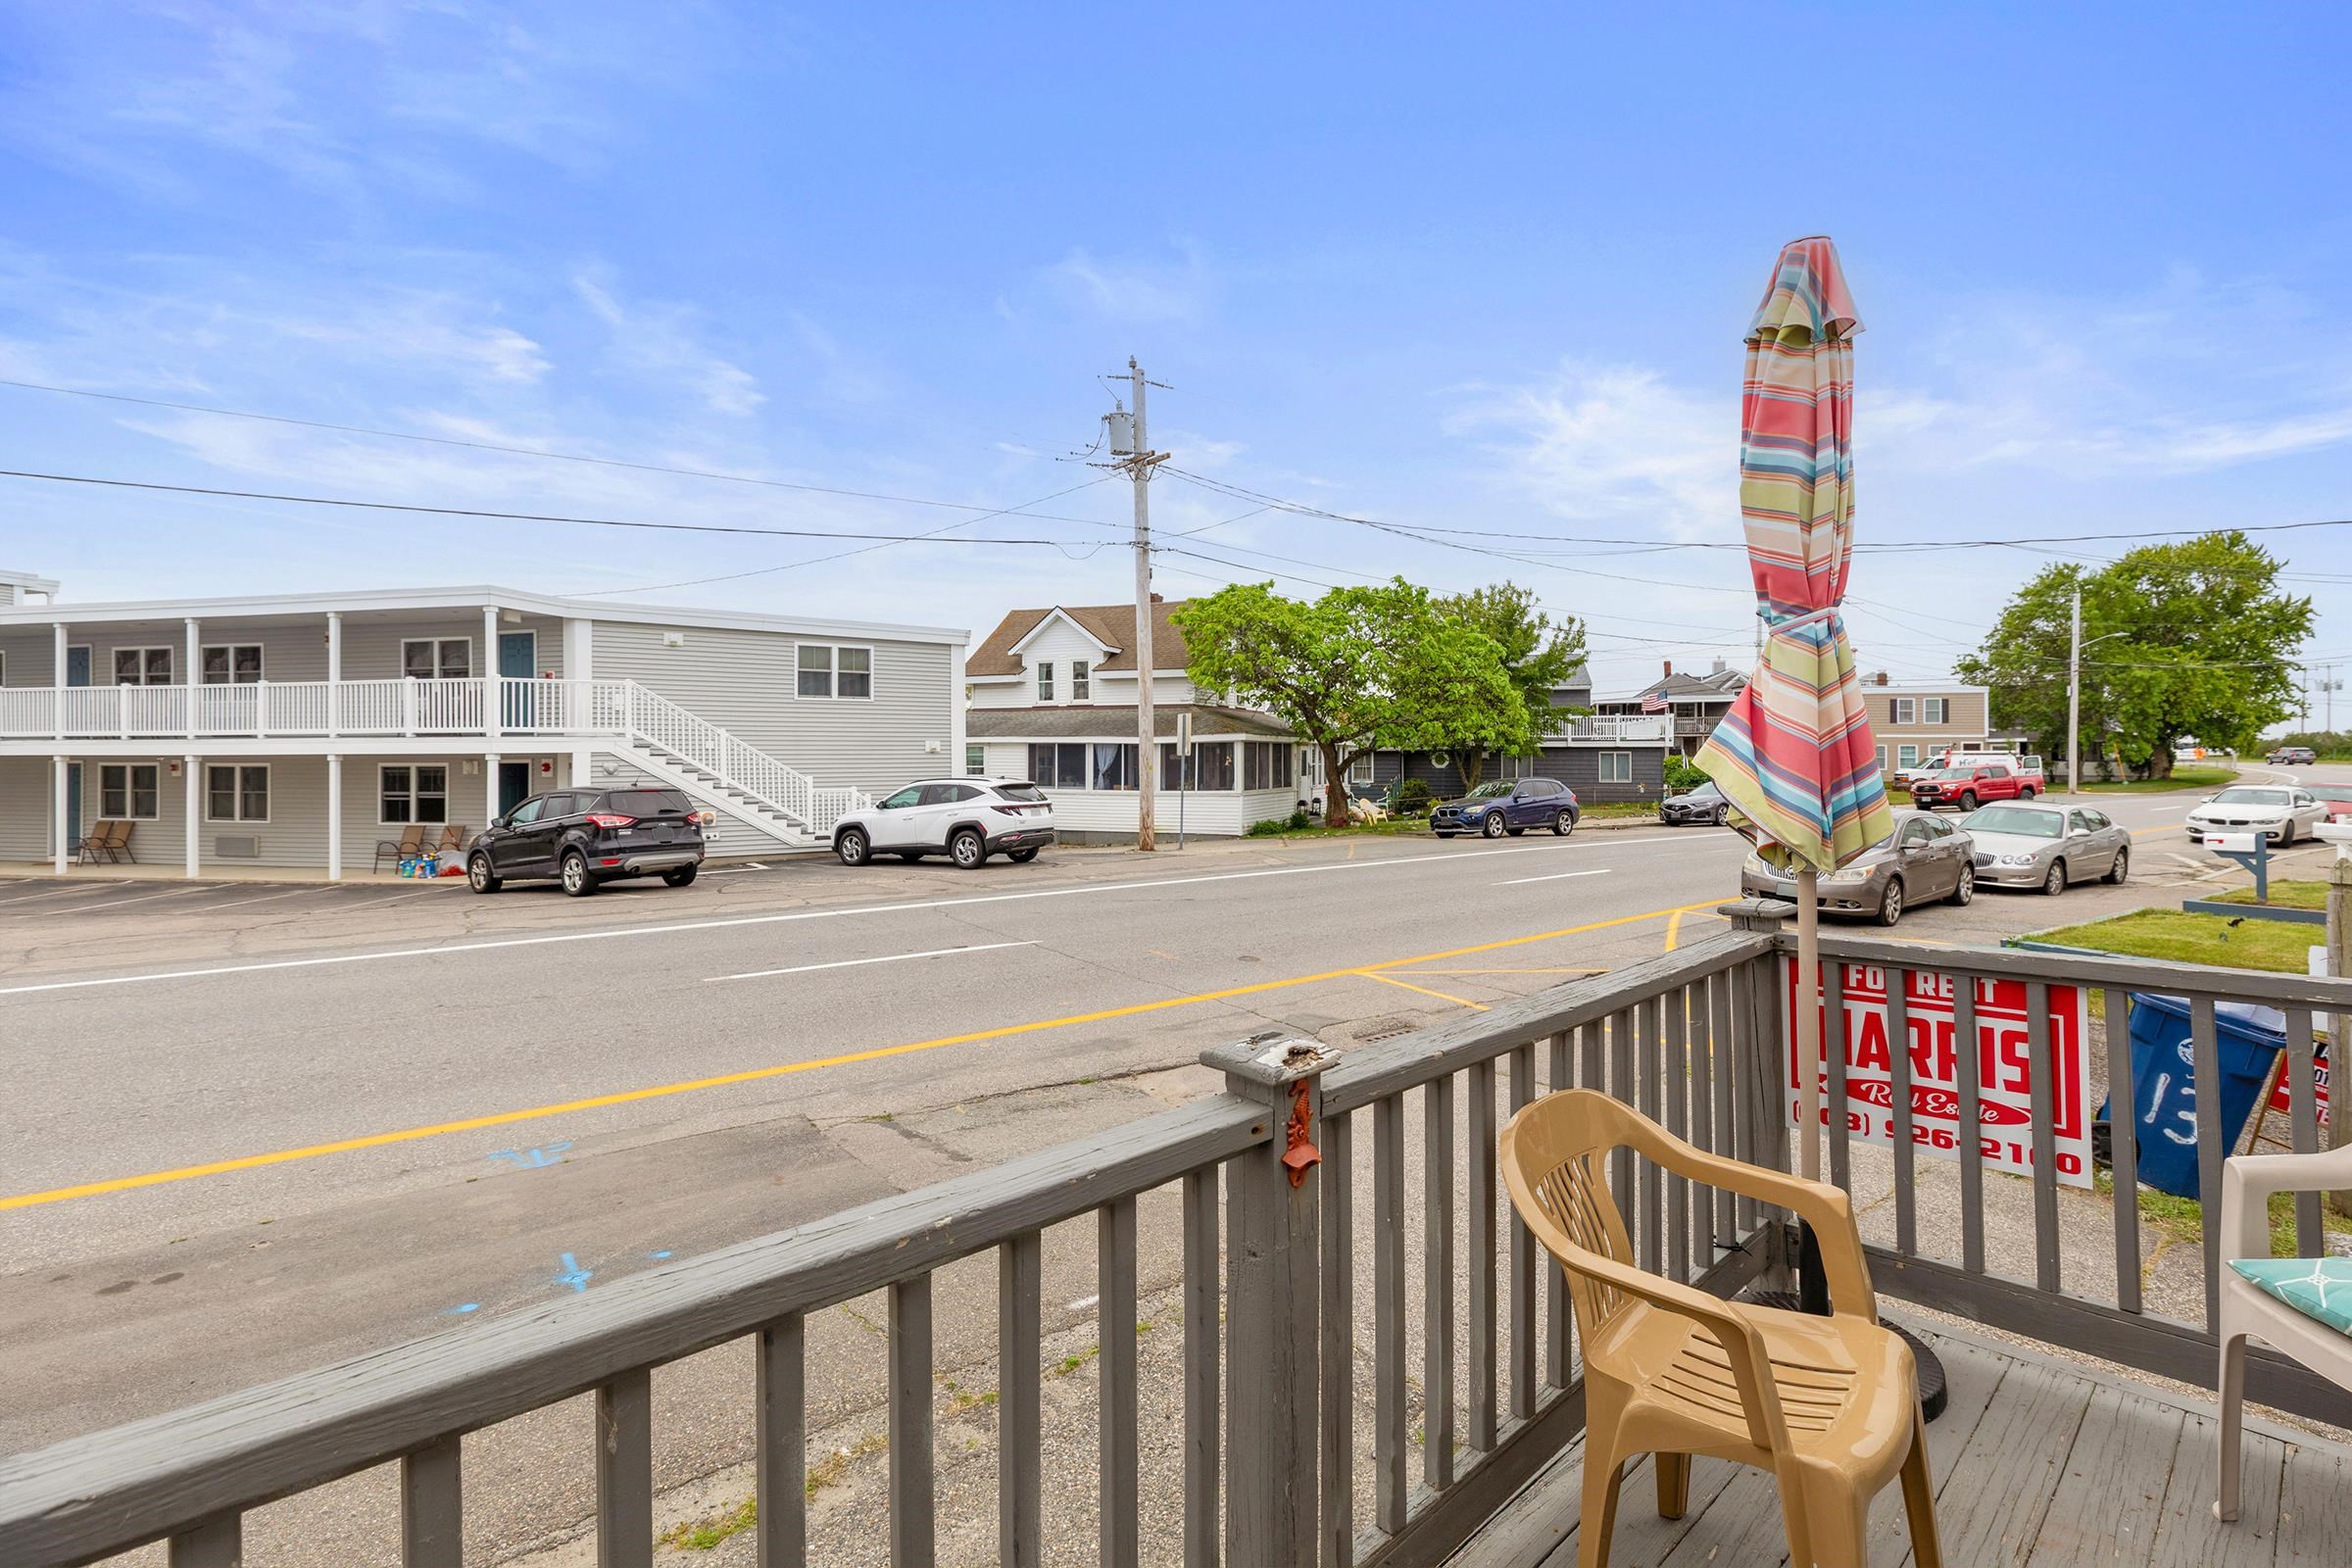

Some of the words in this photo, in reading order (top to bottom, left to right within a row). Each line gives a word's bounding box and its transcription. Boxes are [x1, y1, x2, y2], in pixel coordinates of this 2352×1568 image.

[1848, 963, 1899, 992] FO
[1916, 970, 1998, 1004] RET
[1860, 1083, 1921, 1109] Rl
[1926, 1093, 1999, 1122] Este
[1792, 1100, 1870, 1137] (3)
[1885, 1119, 2082, 1175] 26210
